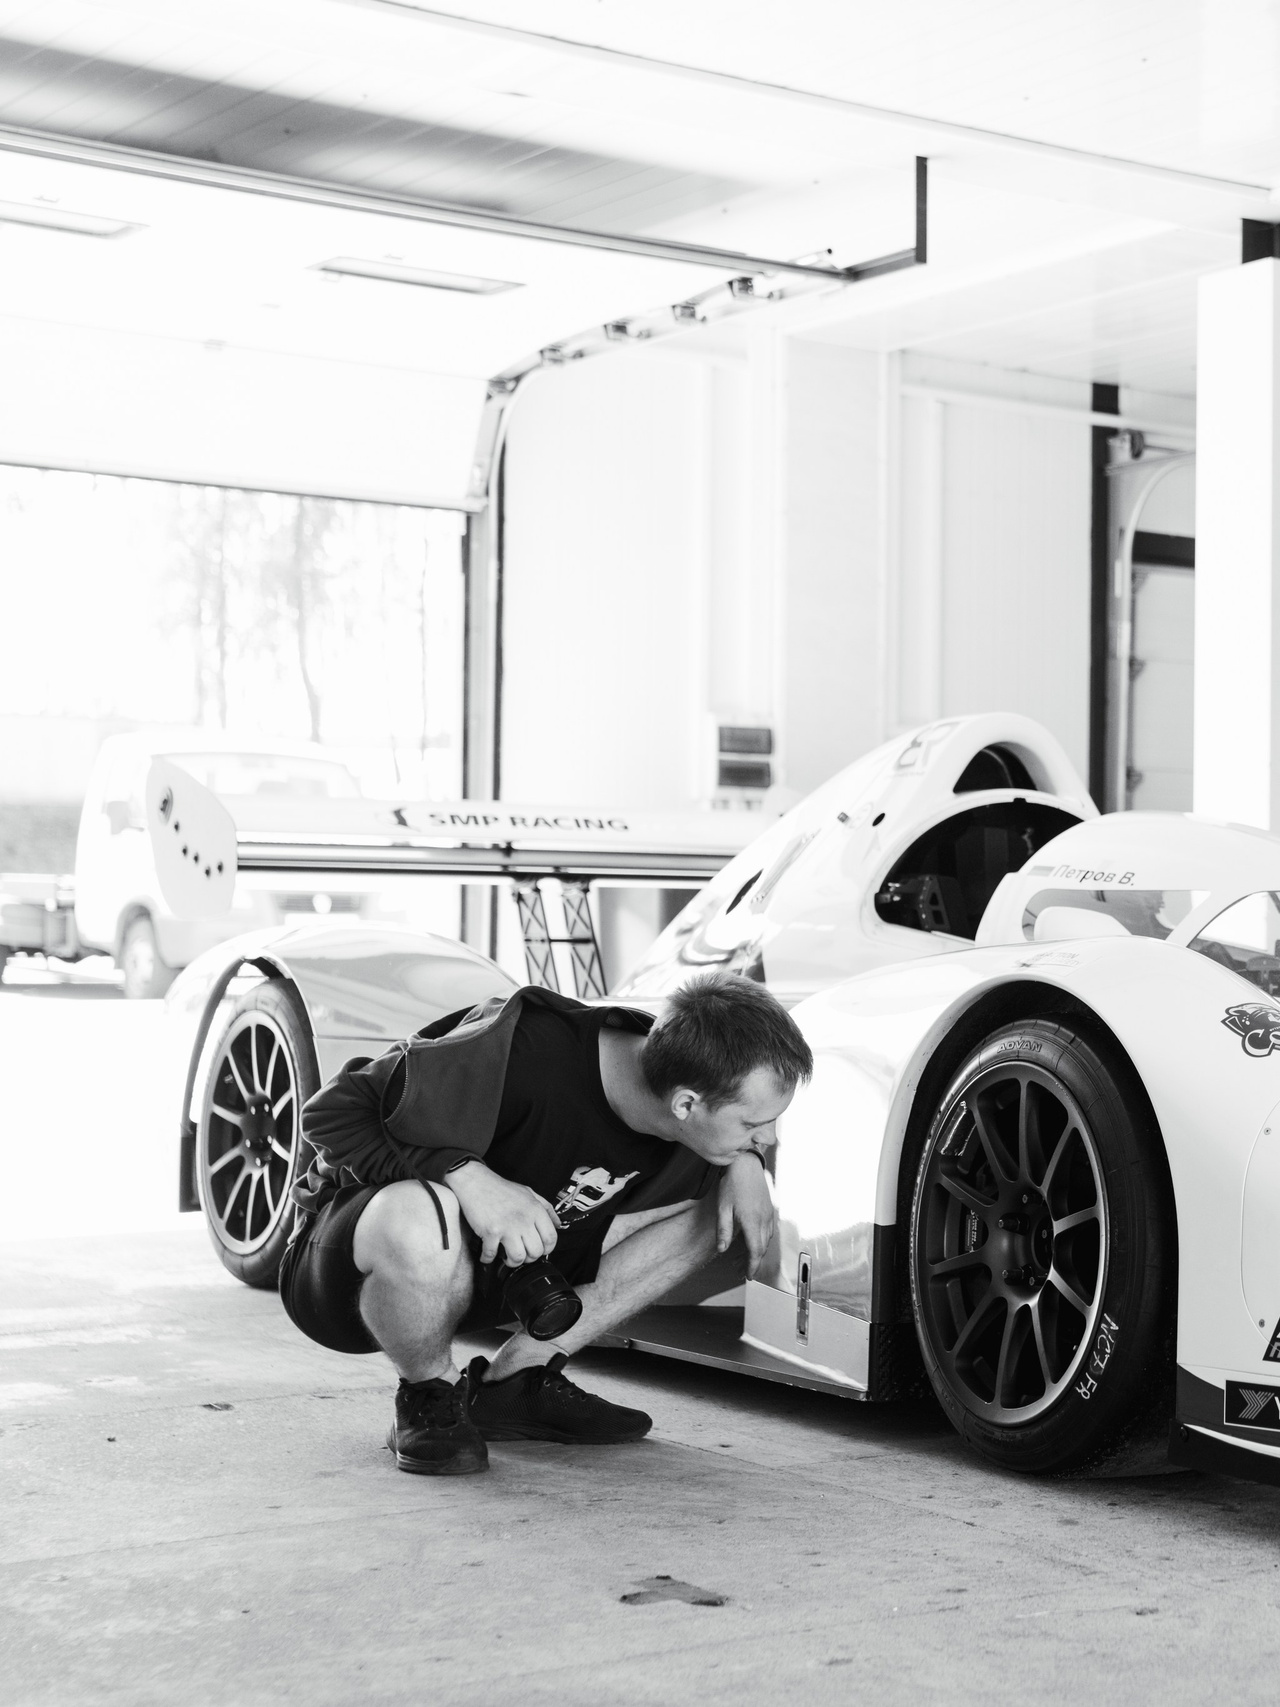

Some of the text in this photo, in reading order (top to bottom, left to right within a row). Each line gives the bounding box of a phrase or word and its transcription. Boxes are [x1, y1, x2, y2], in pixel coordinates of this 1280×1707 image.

[429, 813, 629, 831] SMP RACING
[1053, 864, 1117, 883] Петров
